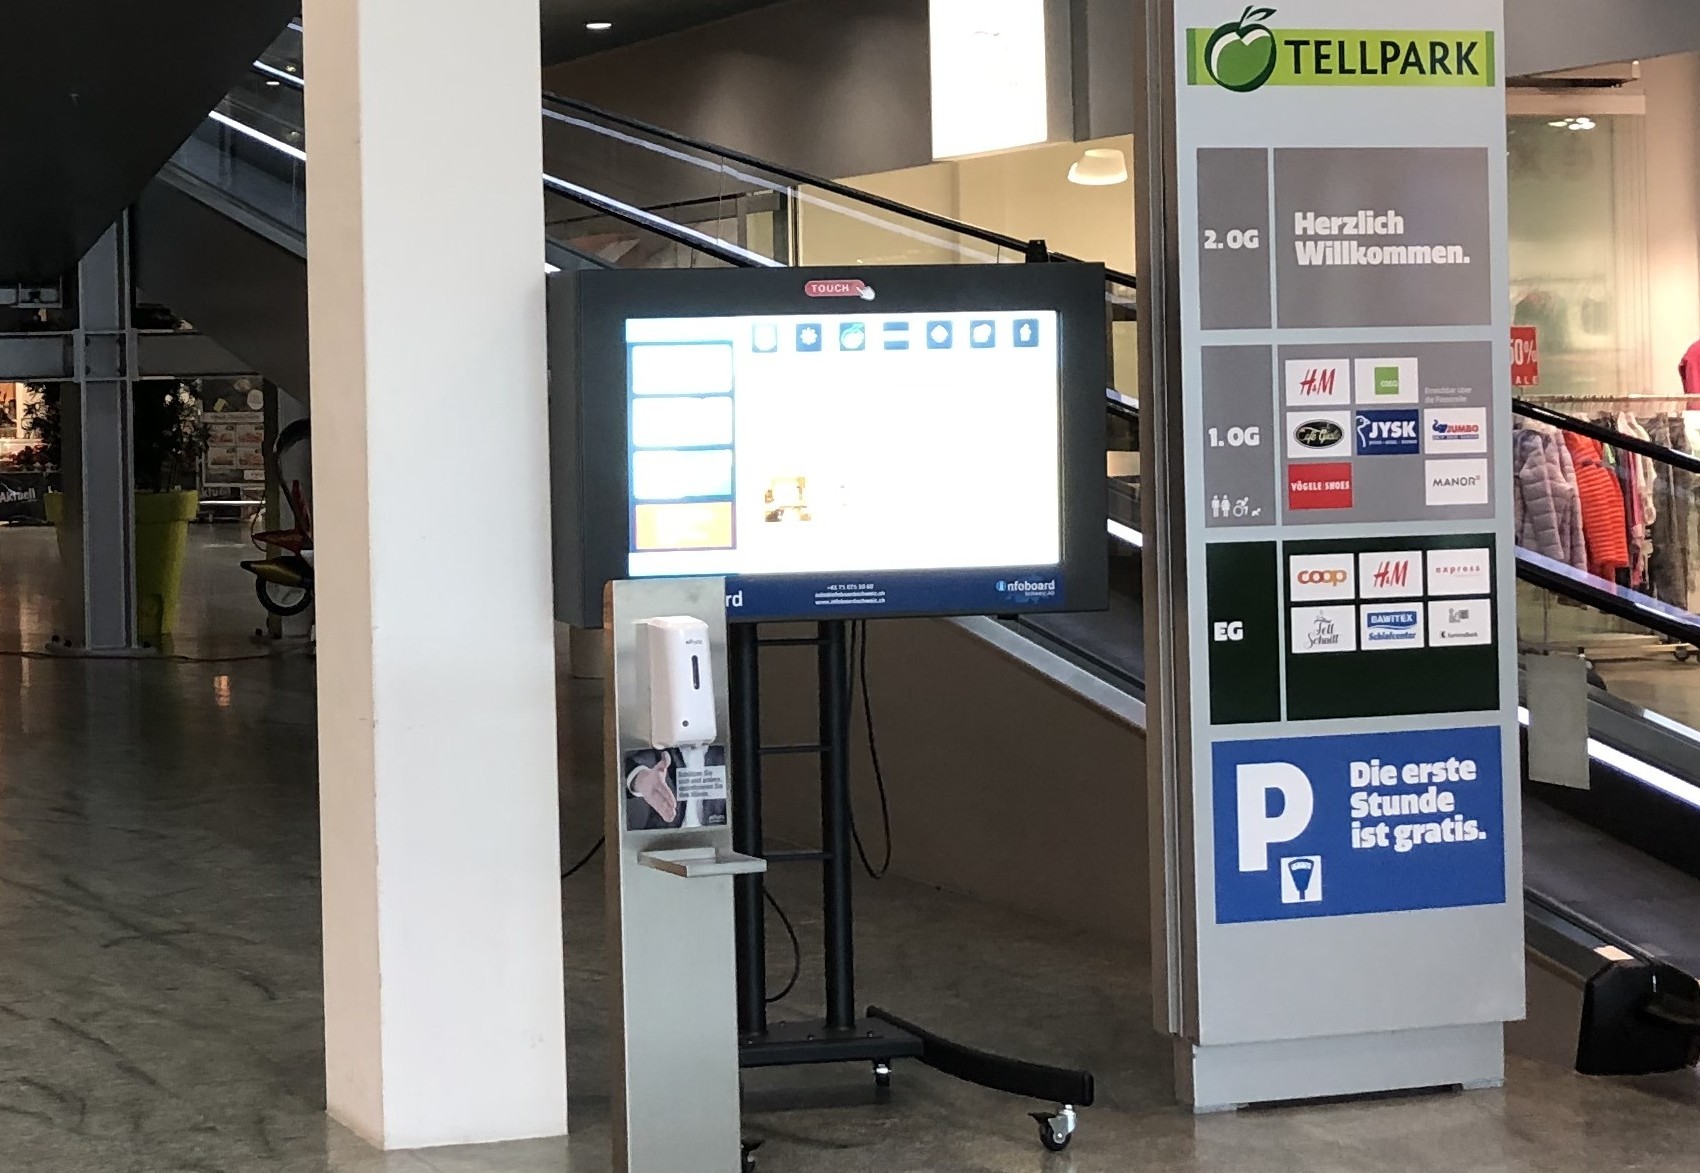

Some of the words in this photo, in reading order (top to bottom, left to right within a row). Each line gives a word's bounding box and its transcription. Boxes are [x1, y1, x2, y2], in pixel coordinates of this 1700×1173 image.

[1284, 39, 1479, 75] TELLPARK
[1294, 210, 1404, 235] Herzlich
[1294, 240, 1471, 265] Willkommen.
[811, 284, 849, 293] TOUCH
[1299, 368, 1336, 396] H&M
[1368, 421, 1417, 439] JYSK
[1432, 476, 1476, 487] MANOR
[1297, 569, 1347, 587] coop
[1373, 560, 1409, 588] H&M
[1435, 565, 1481, 575] express
[1214, 621, 1243, 641] EG
[1350, 759, 1397, 787] Die
[1402, 757, 1477, 784] erste
[1350, 786, 1455, 818] Stunde
[1236, 762, 1314, 872] P
[1351, 821, 1390, 848] ist
[1394, 814, 1487, 852] gratis.
